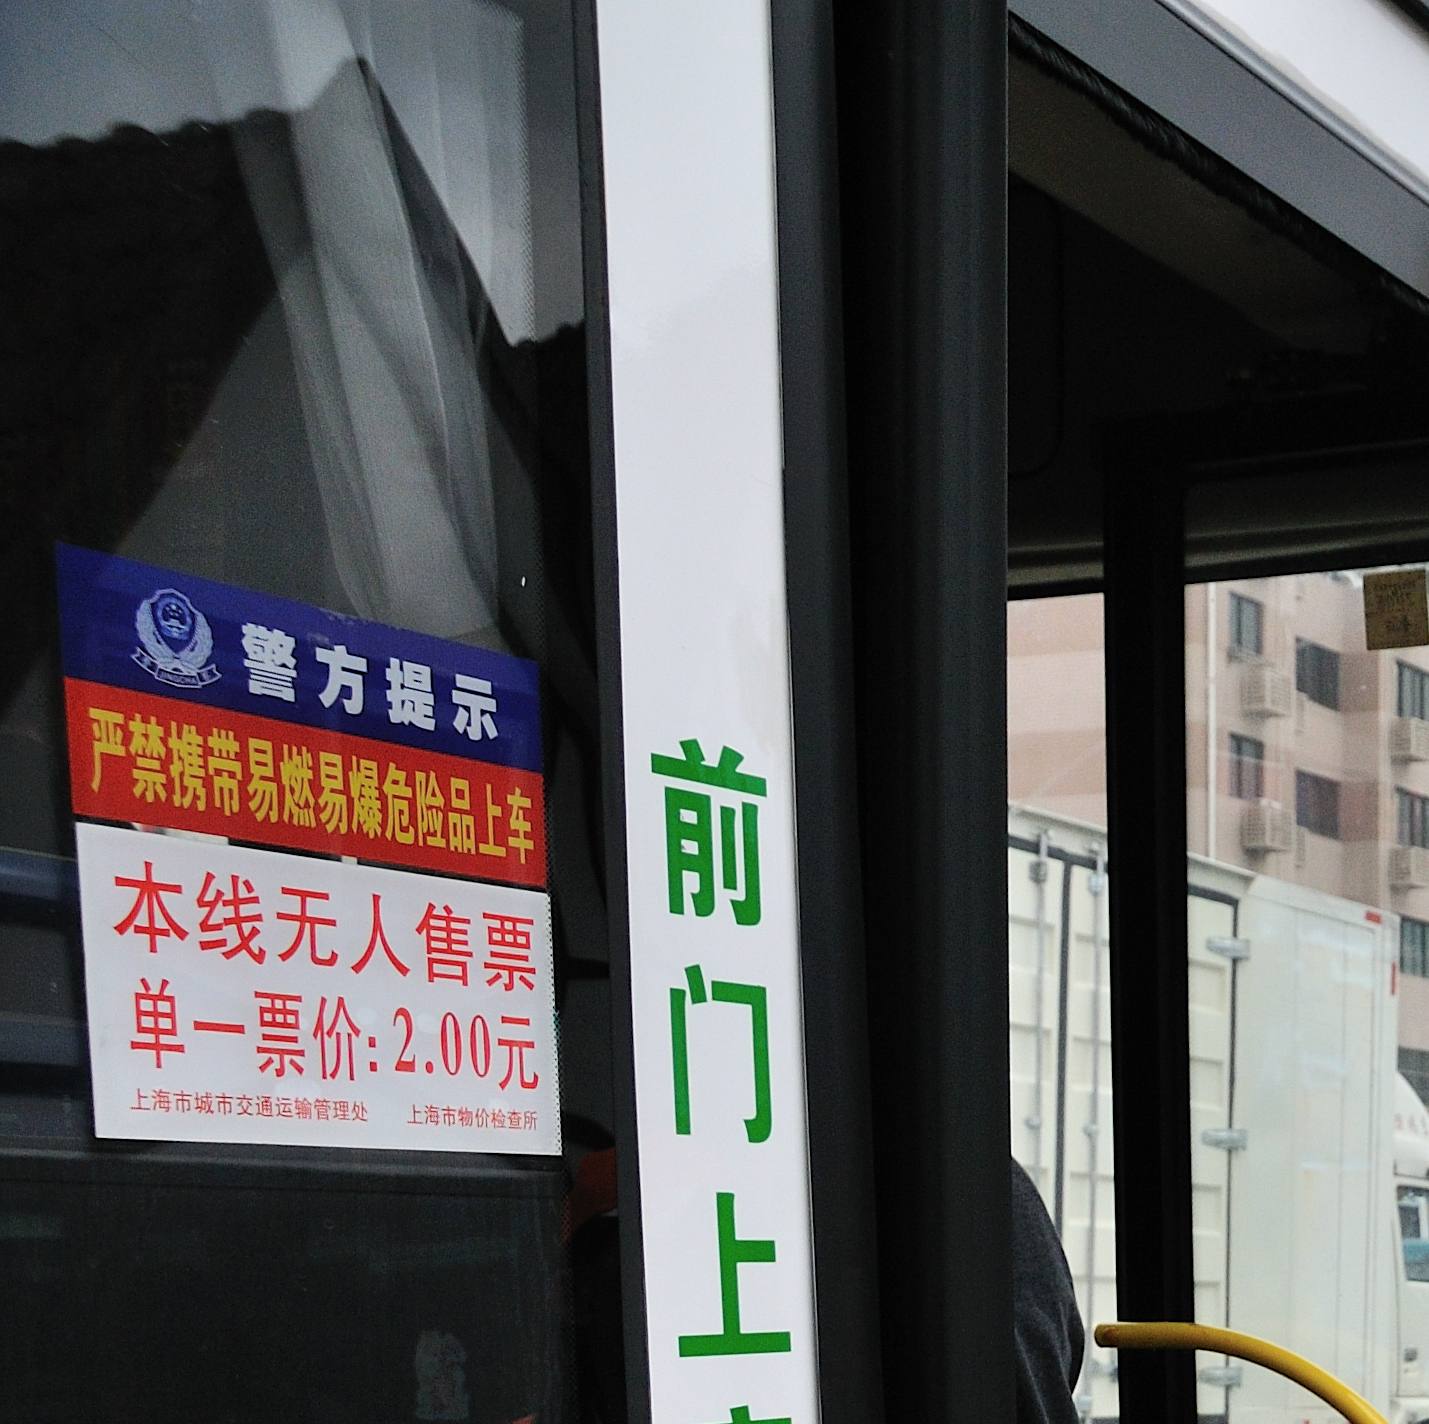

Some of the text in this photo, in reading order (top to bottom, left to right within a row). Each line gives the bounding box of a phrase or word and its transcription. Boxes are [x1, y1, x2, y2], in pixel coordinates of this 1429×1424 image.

[240, 622, 499, 742] 警方提示
[88, 706, 535, 865] 严禁携带易燃易爆危险品上车
[113, 860, 537, 993] 本线无人售票
[130, 1087, 538, 1131] 上海市城市交通运输管理处 上海市物价检查所
